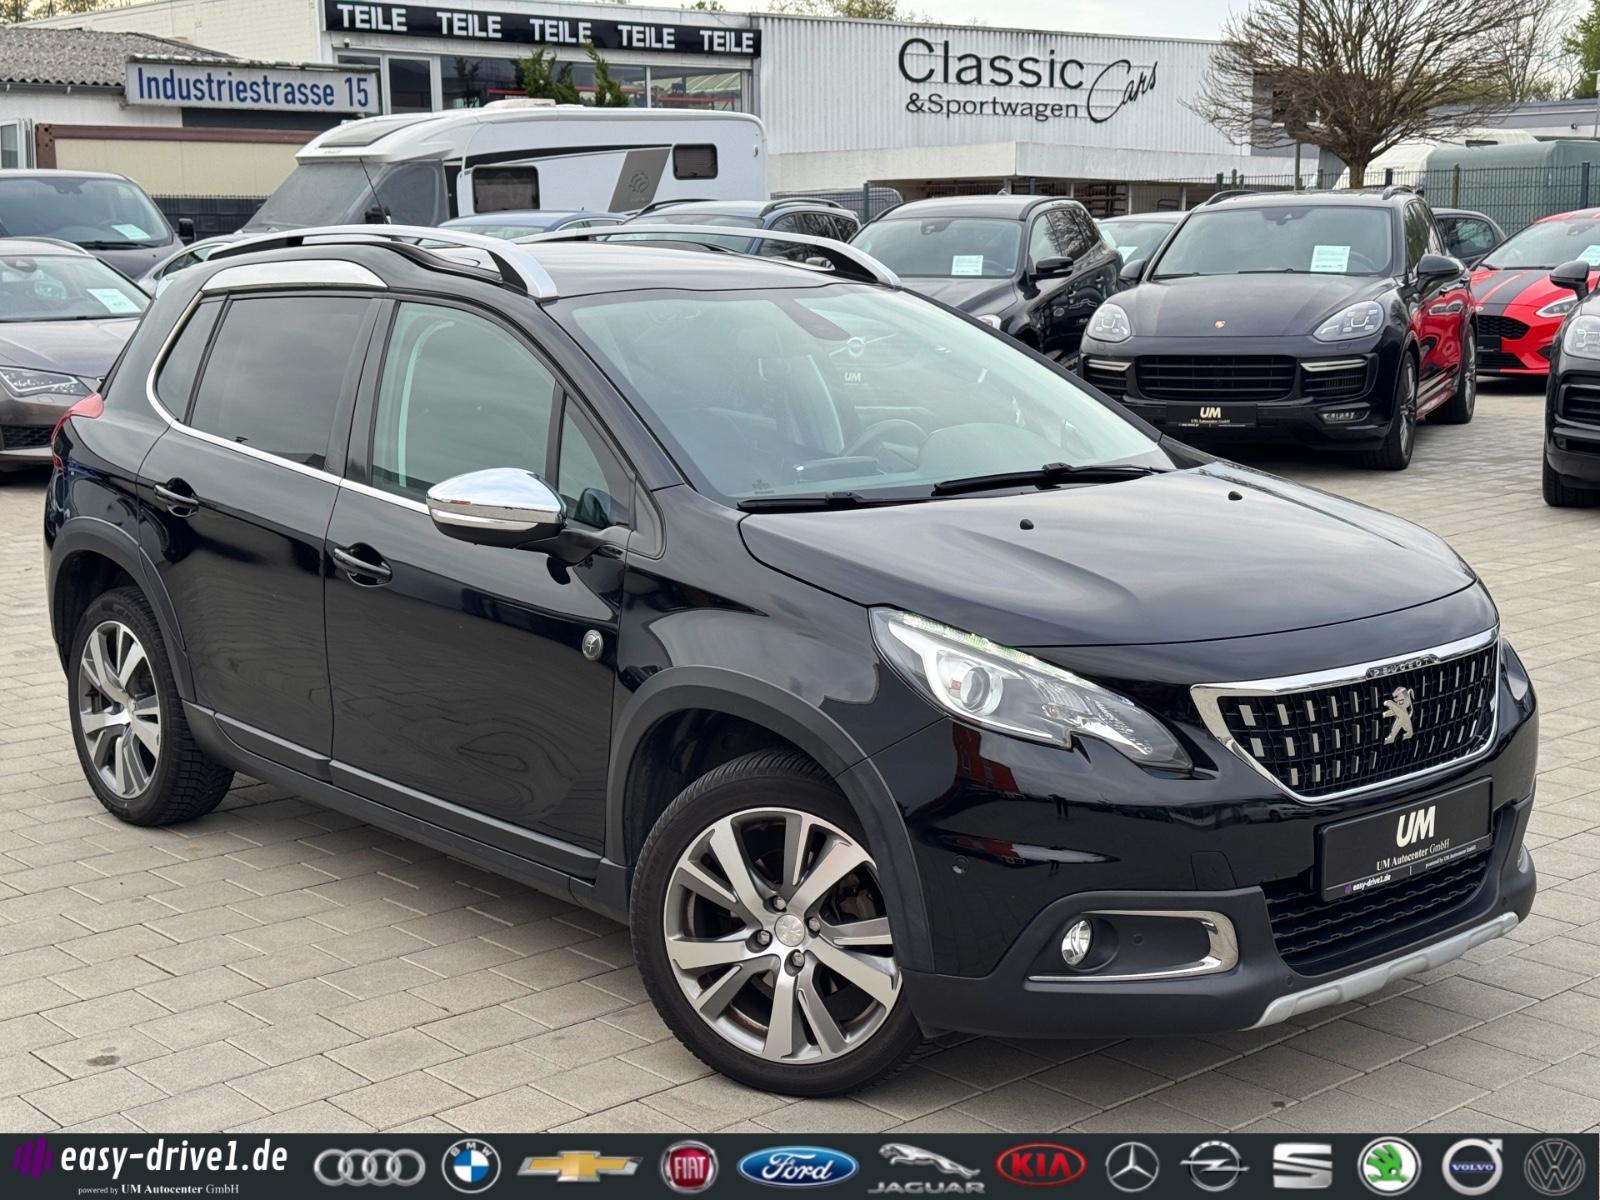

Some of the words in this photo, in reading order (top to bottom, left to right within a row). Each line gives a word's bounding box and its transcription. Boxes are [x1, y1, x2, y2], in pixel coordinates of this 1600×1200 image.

[337, 3, 407, 32] TEILE
[436, 11, 502, 39] TEILE
[529, 18, 592, 44] TEILE
[617, 24, 676, 50] TEILE
[699, 29, 754, 54] TEILE
[137, 66, 335, 106] Industriestrasse
[344, 77, 369, 107] 15
[898, 37, 1084, 89] Classic
[1086, 59, 1158, 123] Cars
[905, 92, 1078, 122] &Sportwagen
[1200, 407, 1221, 418] UM
[1396, 805, 1436, 847] UM
[1376, 857, 1391, 871] UM
[1391, 847, 1428, 866] Autocenter
[1429, 838, 1450, 854] GmbH
